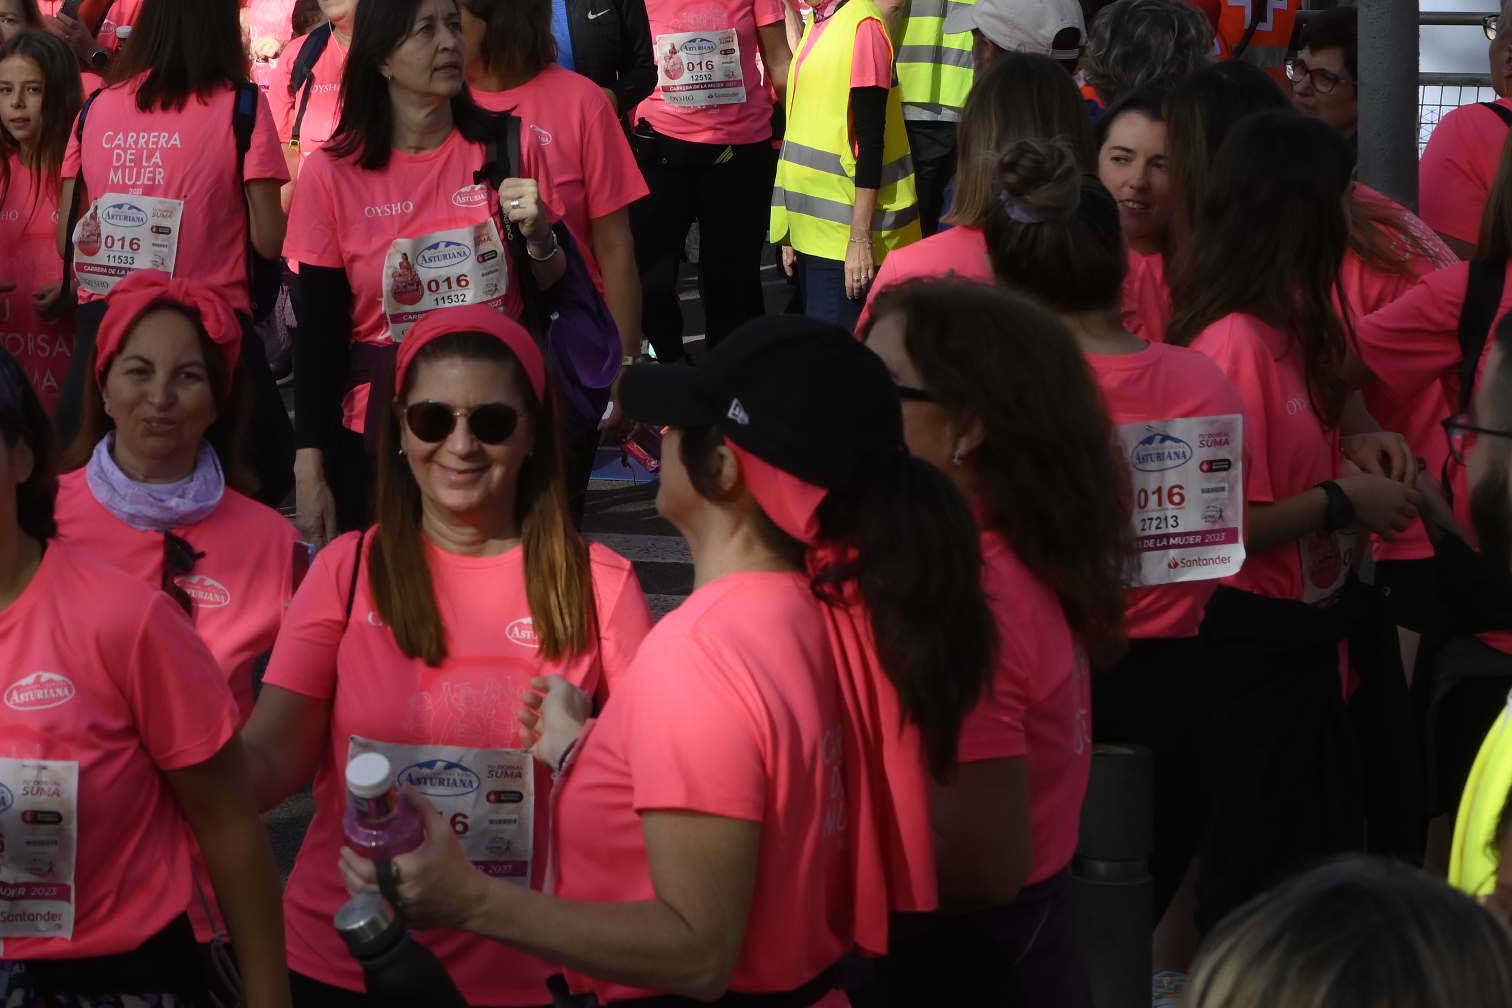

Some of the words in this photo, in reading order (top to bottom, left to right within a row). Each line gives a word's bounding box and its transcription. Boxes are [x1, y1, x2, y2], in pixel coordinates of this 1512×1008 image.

[687, 60, 714, 72] 016
[310, 83, 341, 93] OYSH
[102, 131, 182, 148] CARRERA
[112, 150, 137, 167] DE
[143, 150, 163, 166] LA
[108, 168, 165, 185] MUJER
[364, 201, 414, 218] OYSHO
[456, 192, 488, 204] ASTURIA
[105, 211, 144, 223] ASTURIANA
[104, 234, 141, 252] 016
[106, 254, 135, 265] 11533
[420, 249, 468, 266] ASTURIANA
[427, 273, 470, 293] 016
[433, 293, 467, 306] 11532
[1199, 438, 1230, 449] SUMA
[1136, 449, 1188, 464] ASTURIANA
[1138, 484, 1186, 509] 016
[1140, 515, 1179, 531] 27213
[1143, 539, 1155, 548] DE
[1157, 538, 1168, 547] LA
[1169, 535, 1202, 546] MUJER
[1180, 554, 1232, 569] Santander
[8, 685, 70, 705] ASTURIANA
[406, 774, 475, 789] ASTURIANA
[488, 769, 523, 780] SUMA
[21, 786, 62, 798] SUMA
[0, 909, 63, 923] Santander
